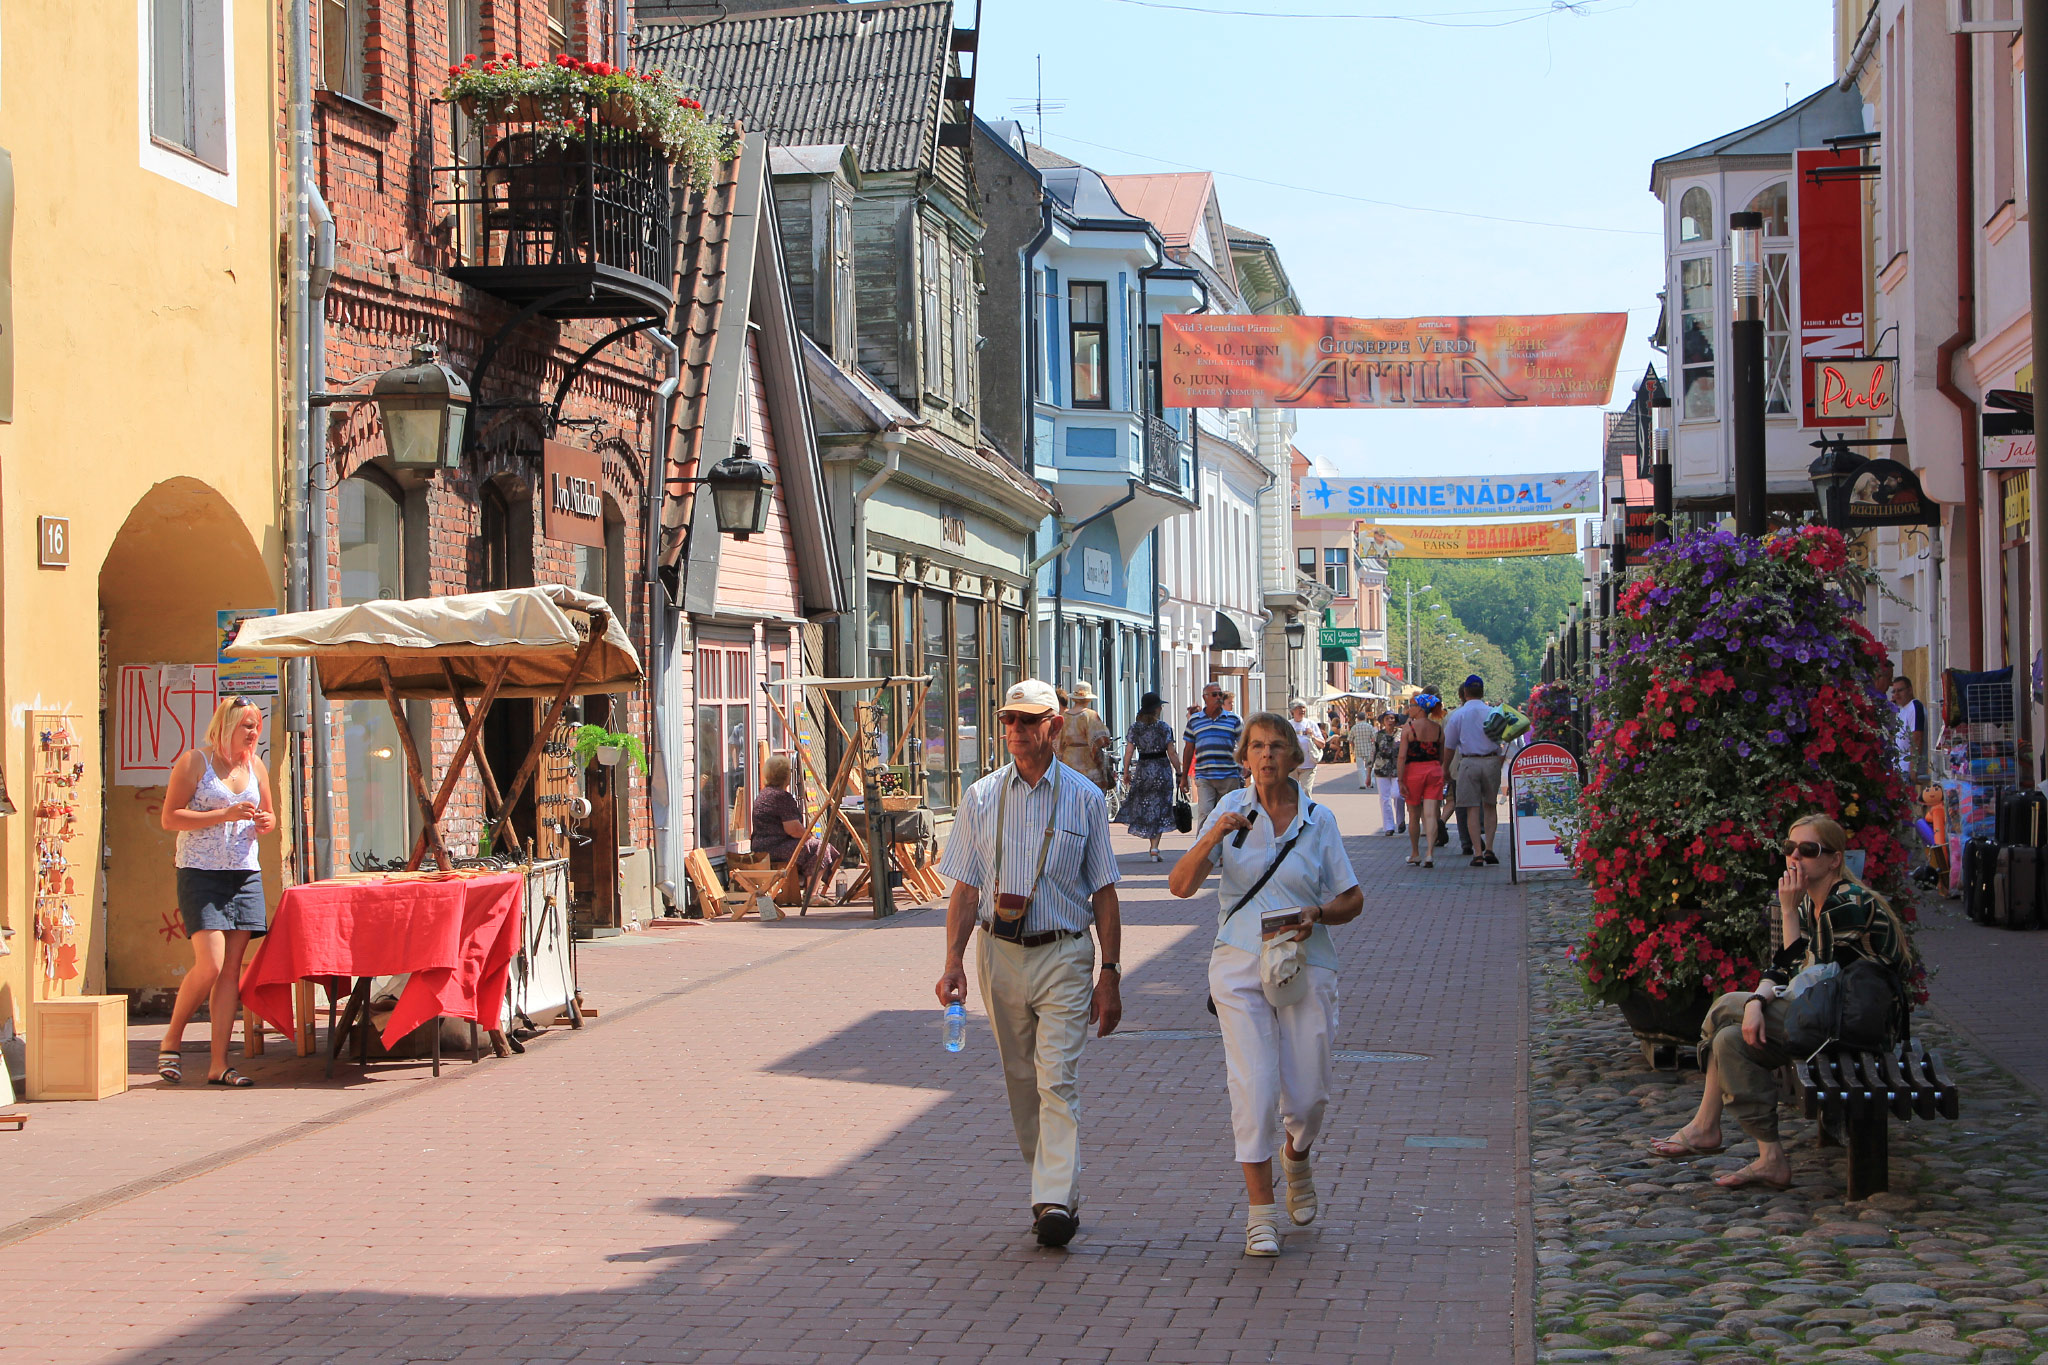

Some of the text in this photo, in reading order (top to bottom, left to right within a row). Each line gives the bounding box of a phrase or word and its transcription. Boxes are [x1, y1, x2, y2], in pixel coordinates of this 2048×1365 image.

[1173, 323, 1283, 333] Vaid 3 etendust Pärnus!
[1173, 343, 1279, 356] 4., 8., 10. JUUNI
[1318, 336, 1476, 354] GIUSEPPE VERDI
[1506, 339, 1547, 351] PEHK
[1197, 358, 1223, 366] ENDLA
[1525, 362, 1574, 379] ÜLLAR
[1173, 373, 1229, 386] 6. JUUNI
[1273, 357, 1528, 402] ATTILA
[1186, 387, 1216, 396] TEATER
[1823, 364, 1886, 416] Pub
[554, 472, 602, 518] Ivo Nikkolo
[1348, 478, 1552, 507] SININE NÄDAL
[1536, 504, 1553, 512] 2011
[48, 523, 64, 555] 16
[1411, 528, 1462, 540] Molière'i
[1466, 525, 1549, 549] EBAHAIGE
[1423, 541, 1459, 550] FARSS
